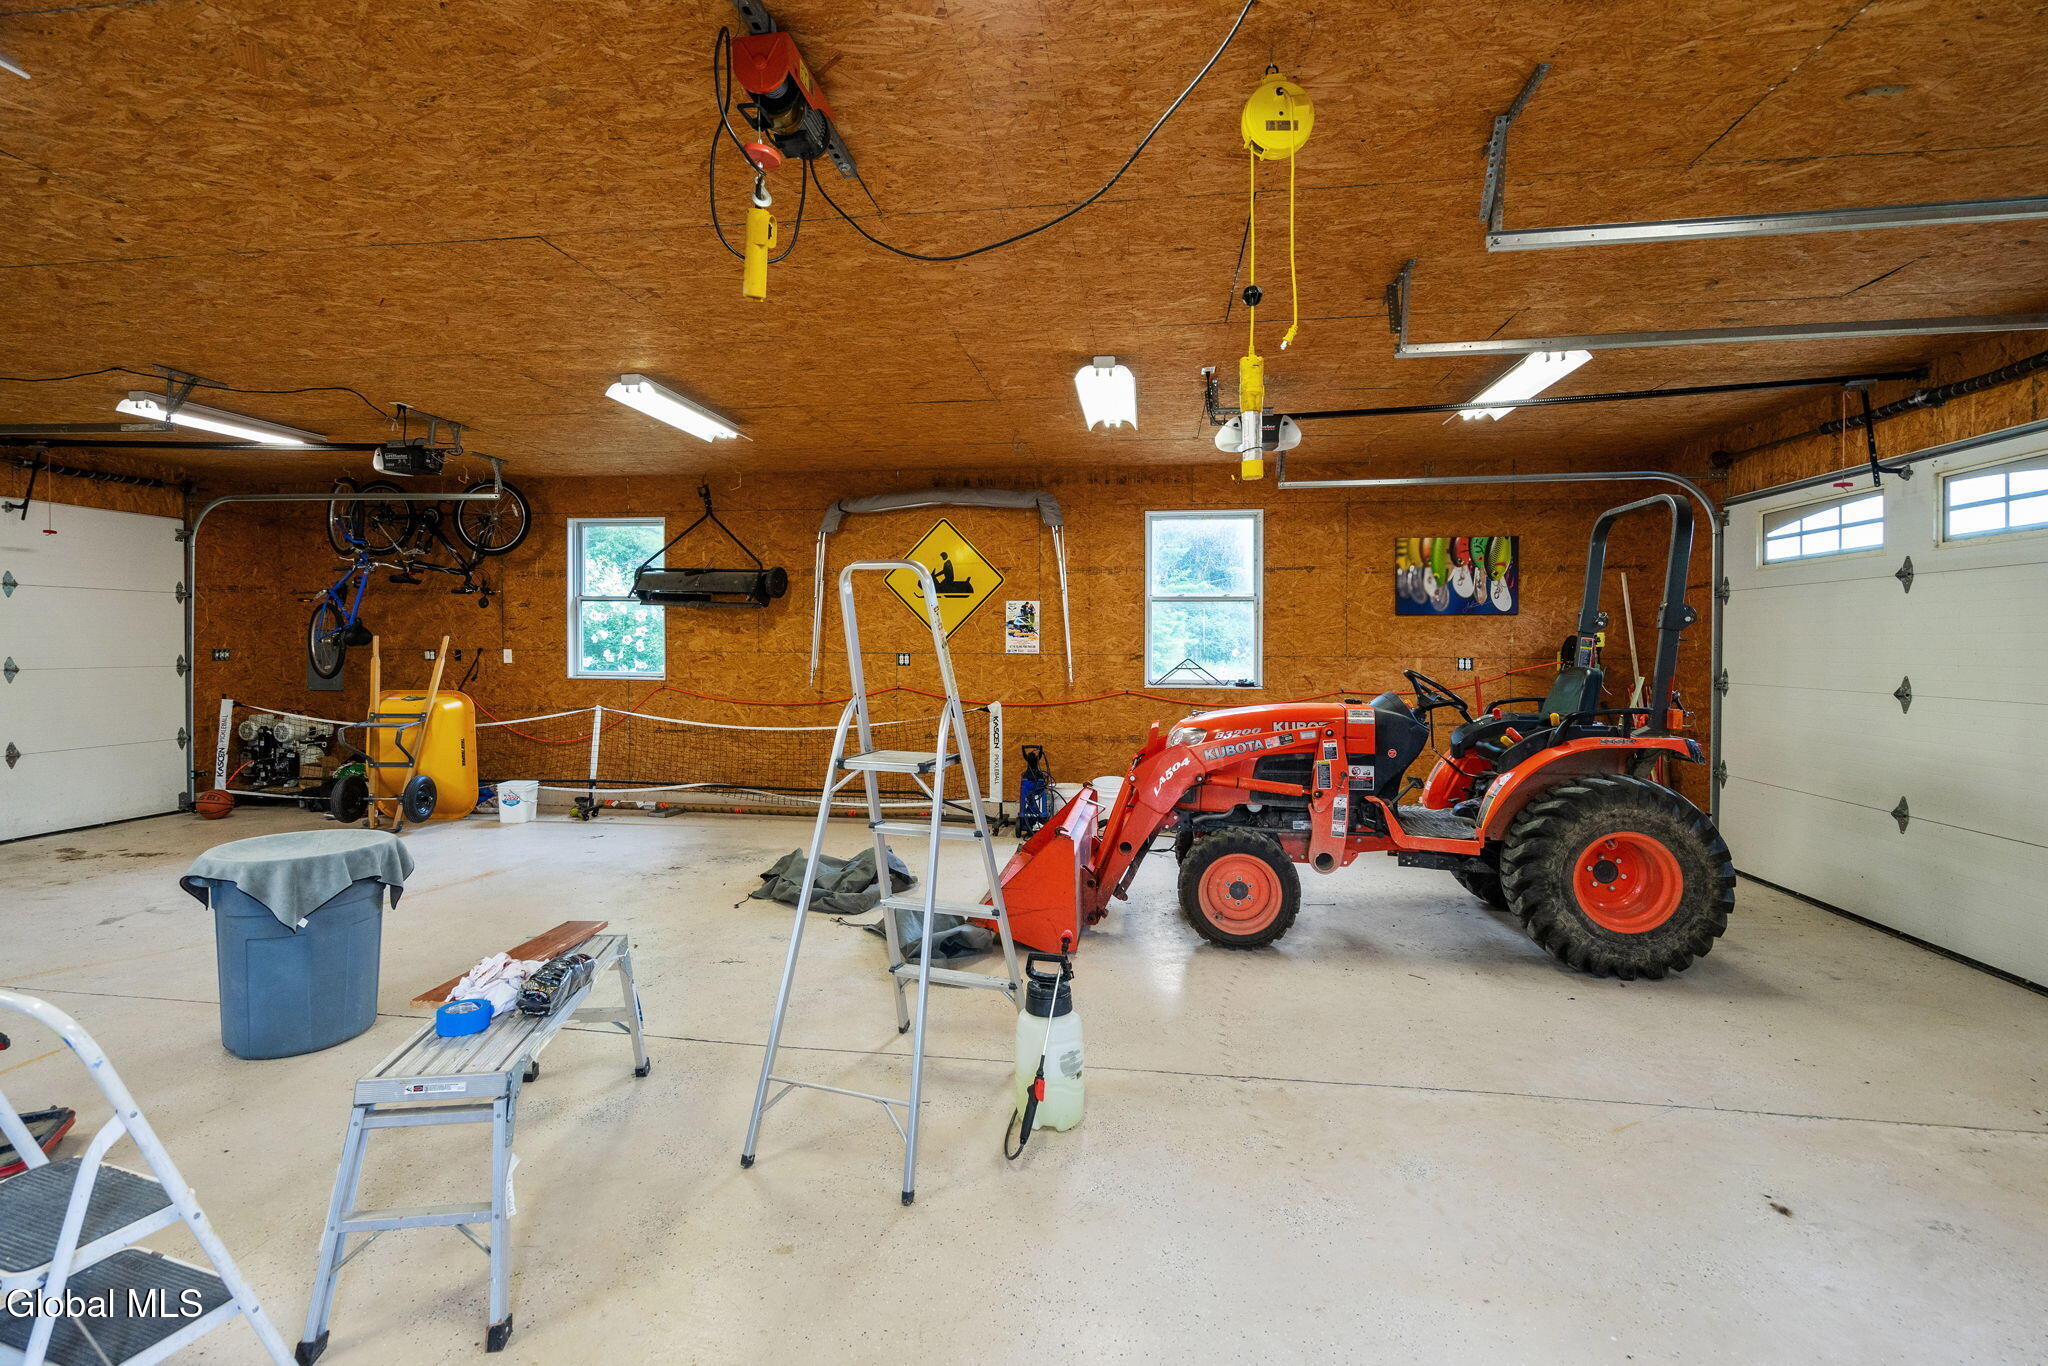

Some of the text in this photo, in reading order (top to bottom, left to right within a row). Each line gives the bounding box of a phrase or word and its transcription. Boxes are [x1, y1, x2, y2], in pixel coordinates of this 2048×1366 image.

[1214, 727, 1262, 740] B3200
[1203, 739, 1265, 761] KUBOTA
[1153, 757, 1191, 797] LA504
